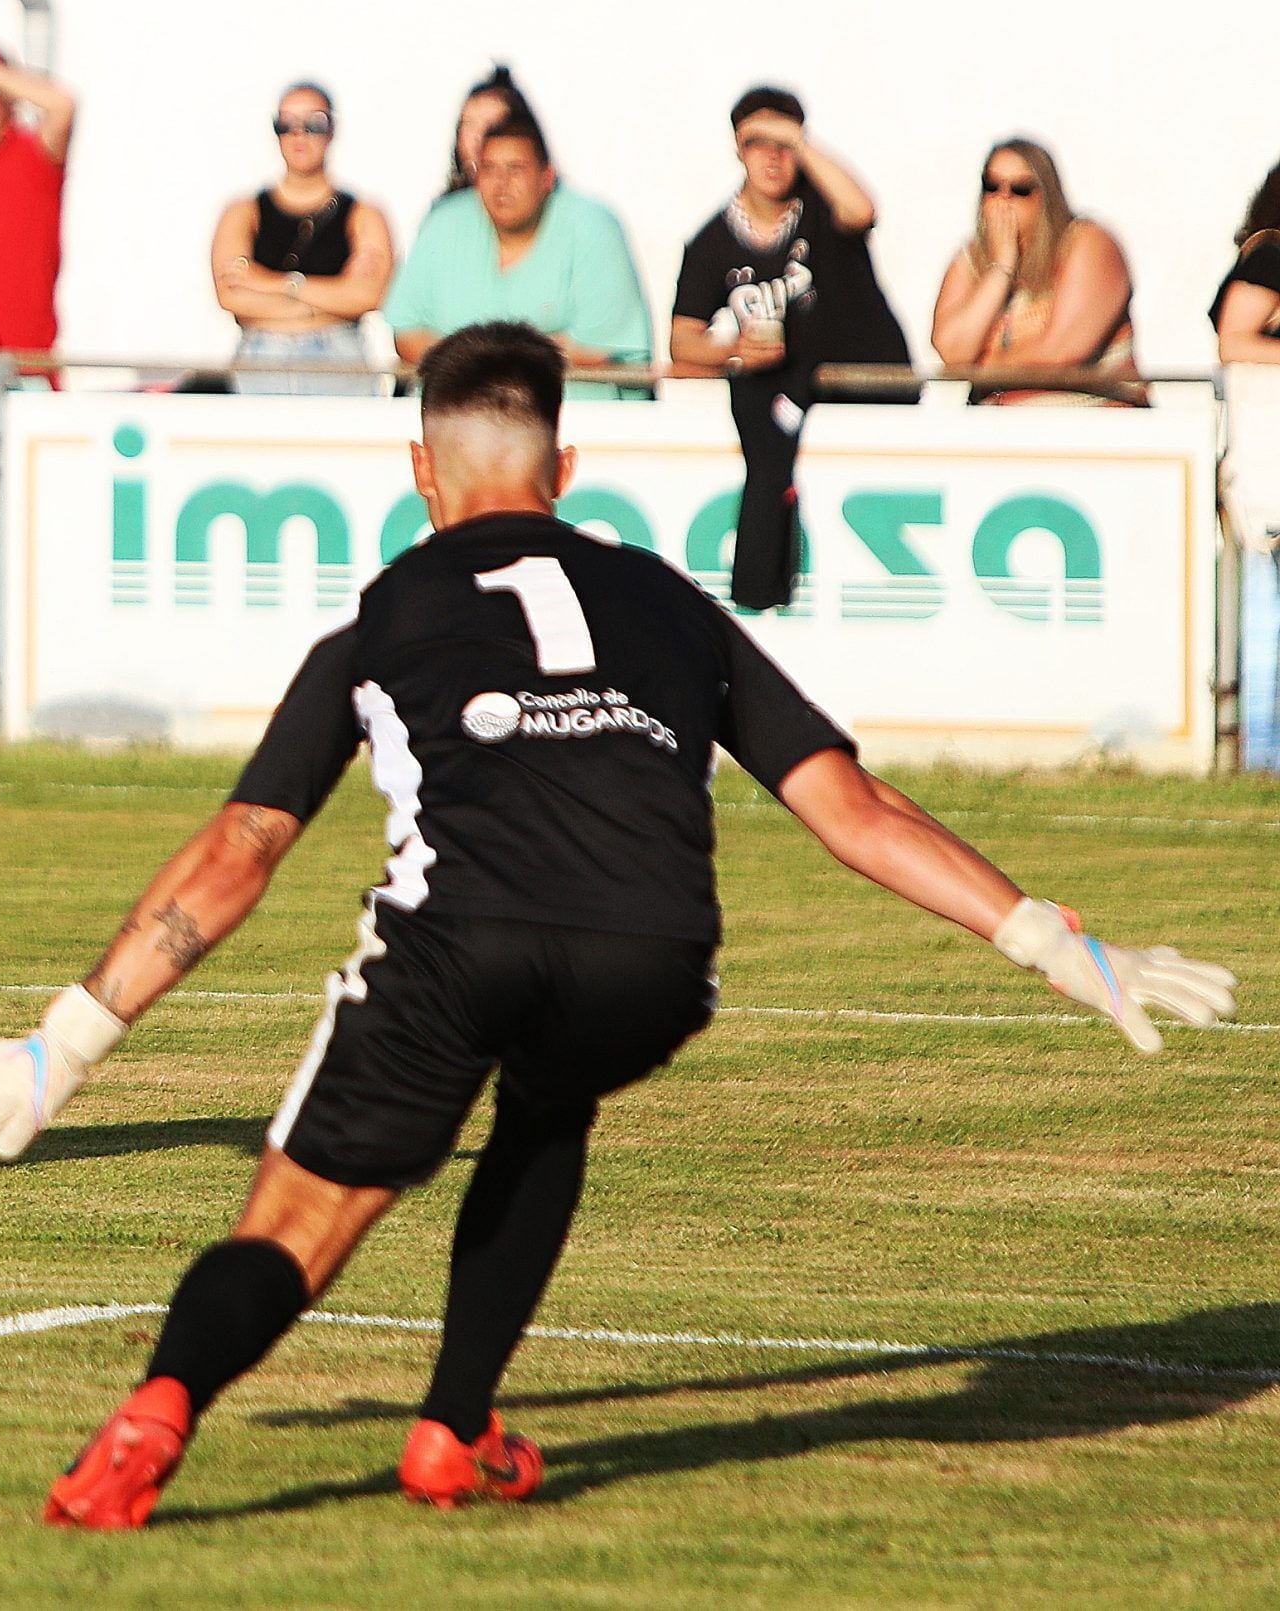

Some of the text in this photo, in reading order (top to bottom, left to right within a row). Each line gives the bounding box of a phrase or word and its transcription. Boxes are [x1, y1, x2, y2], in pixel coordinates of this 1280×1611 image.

[472, 555, 597, 677] 1
[516, 687, 629, 709] Concello de
[520, 705, 679, 755] MUGARDOS
